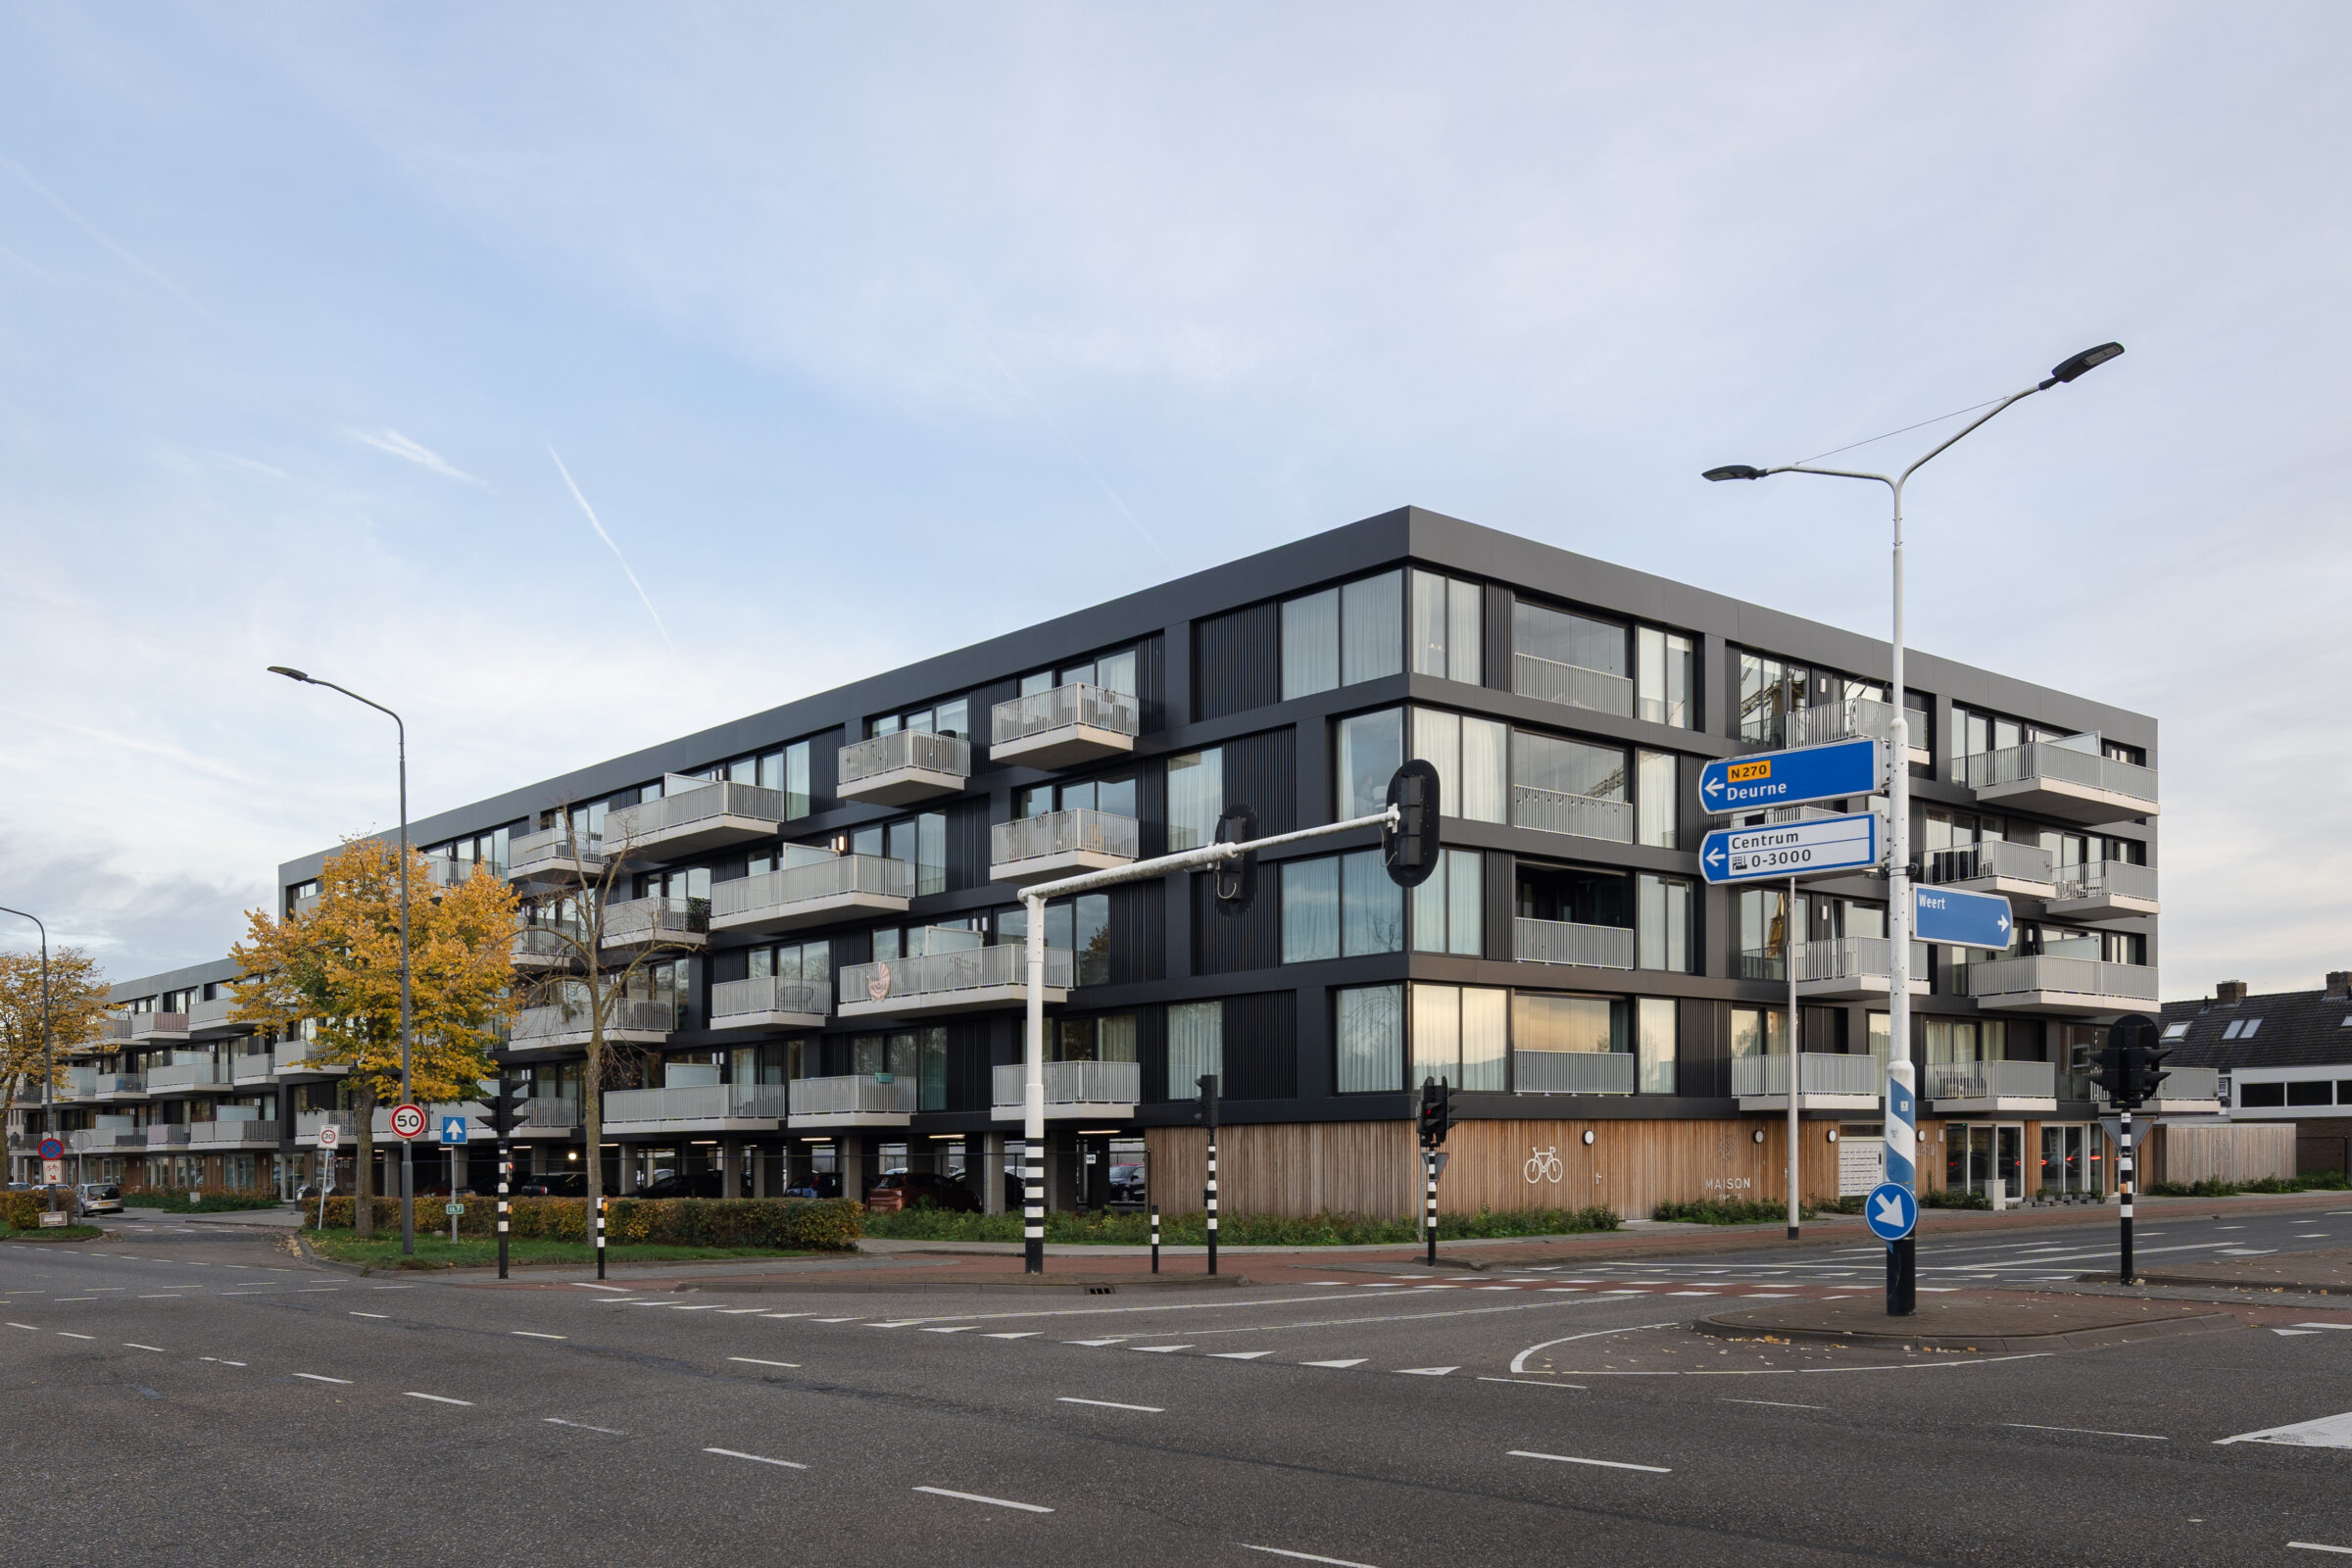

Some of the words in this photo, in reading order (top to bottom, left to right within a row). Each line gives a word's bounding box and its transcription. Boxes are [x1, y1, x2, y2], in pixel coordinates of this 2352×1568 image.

[1727, 782, 1788, 802] Deurne
[1732, 832, 1799, 850] Centrum
[1751, 849, 1812, 867] 0-3000
[1918, 893, 1946, 910] Weert
[397, 1114, 419, 1128] 50
[1705, 1177, 1751, 1190] MAISON
